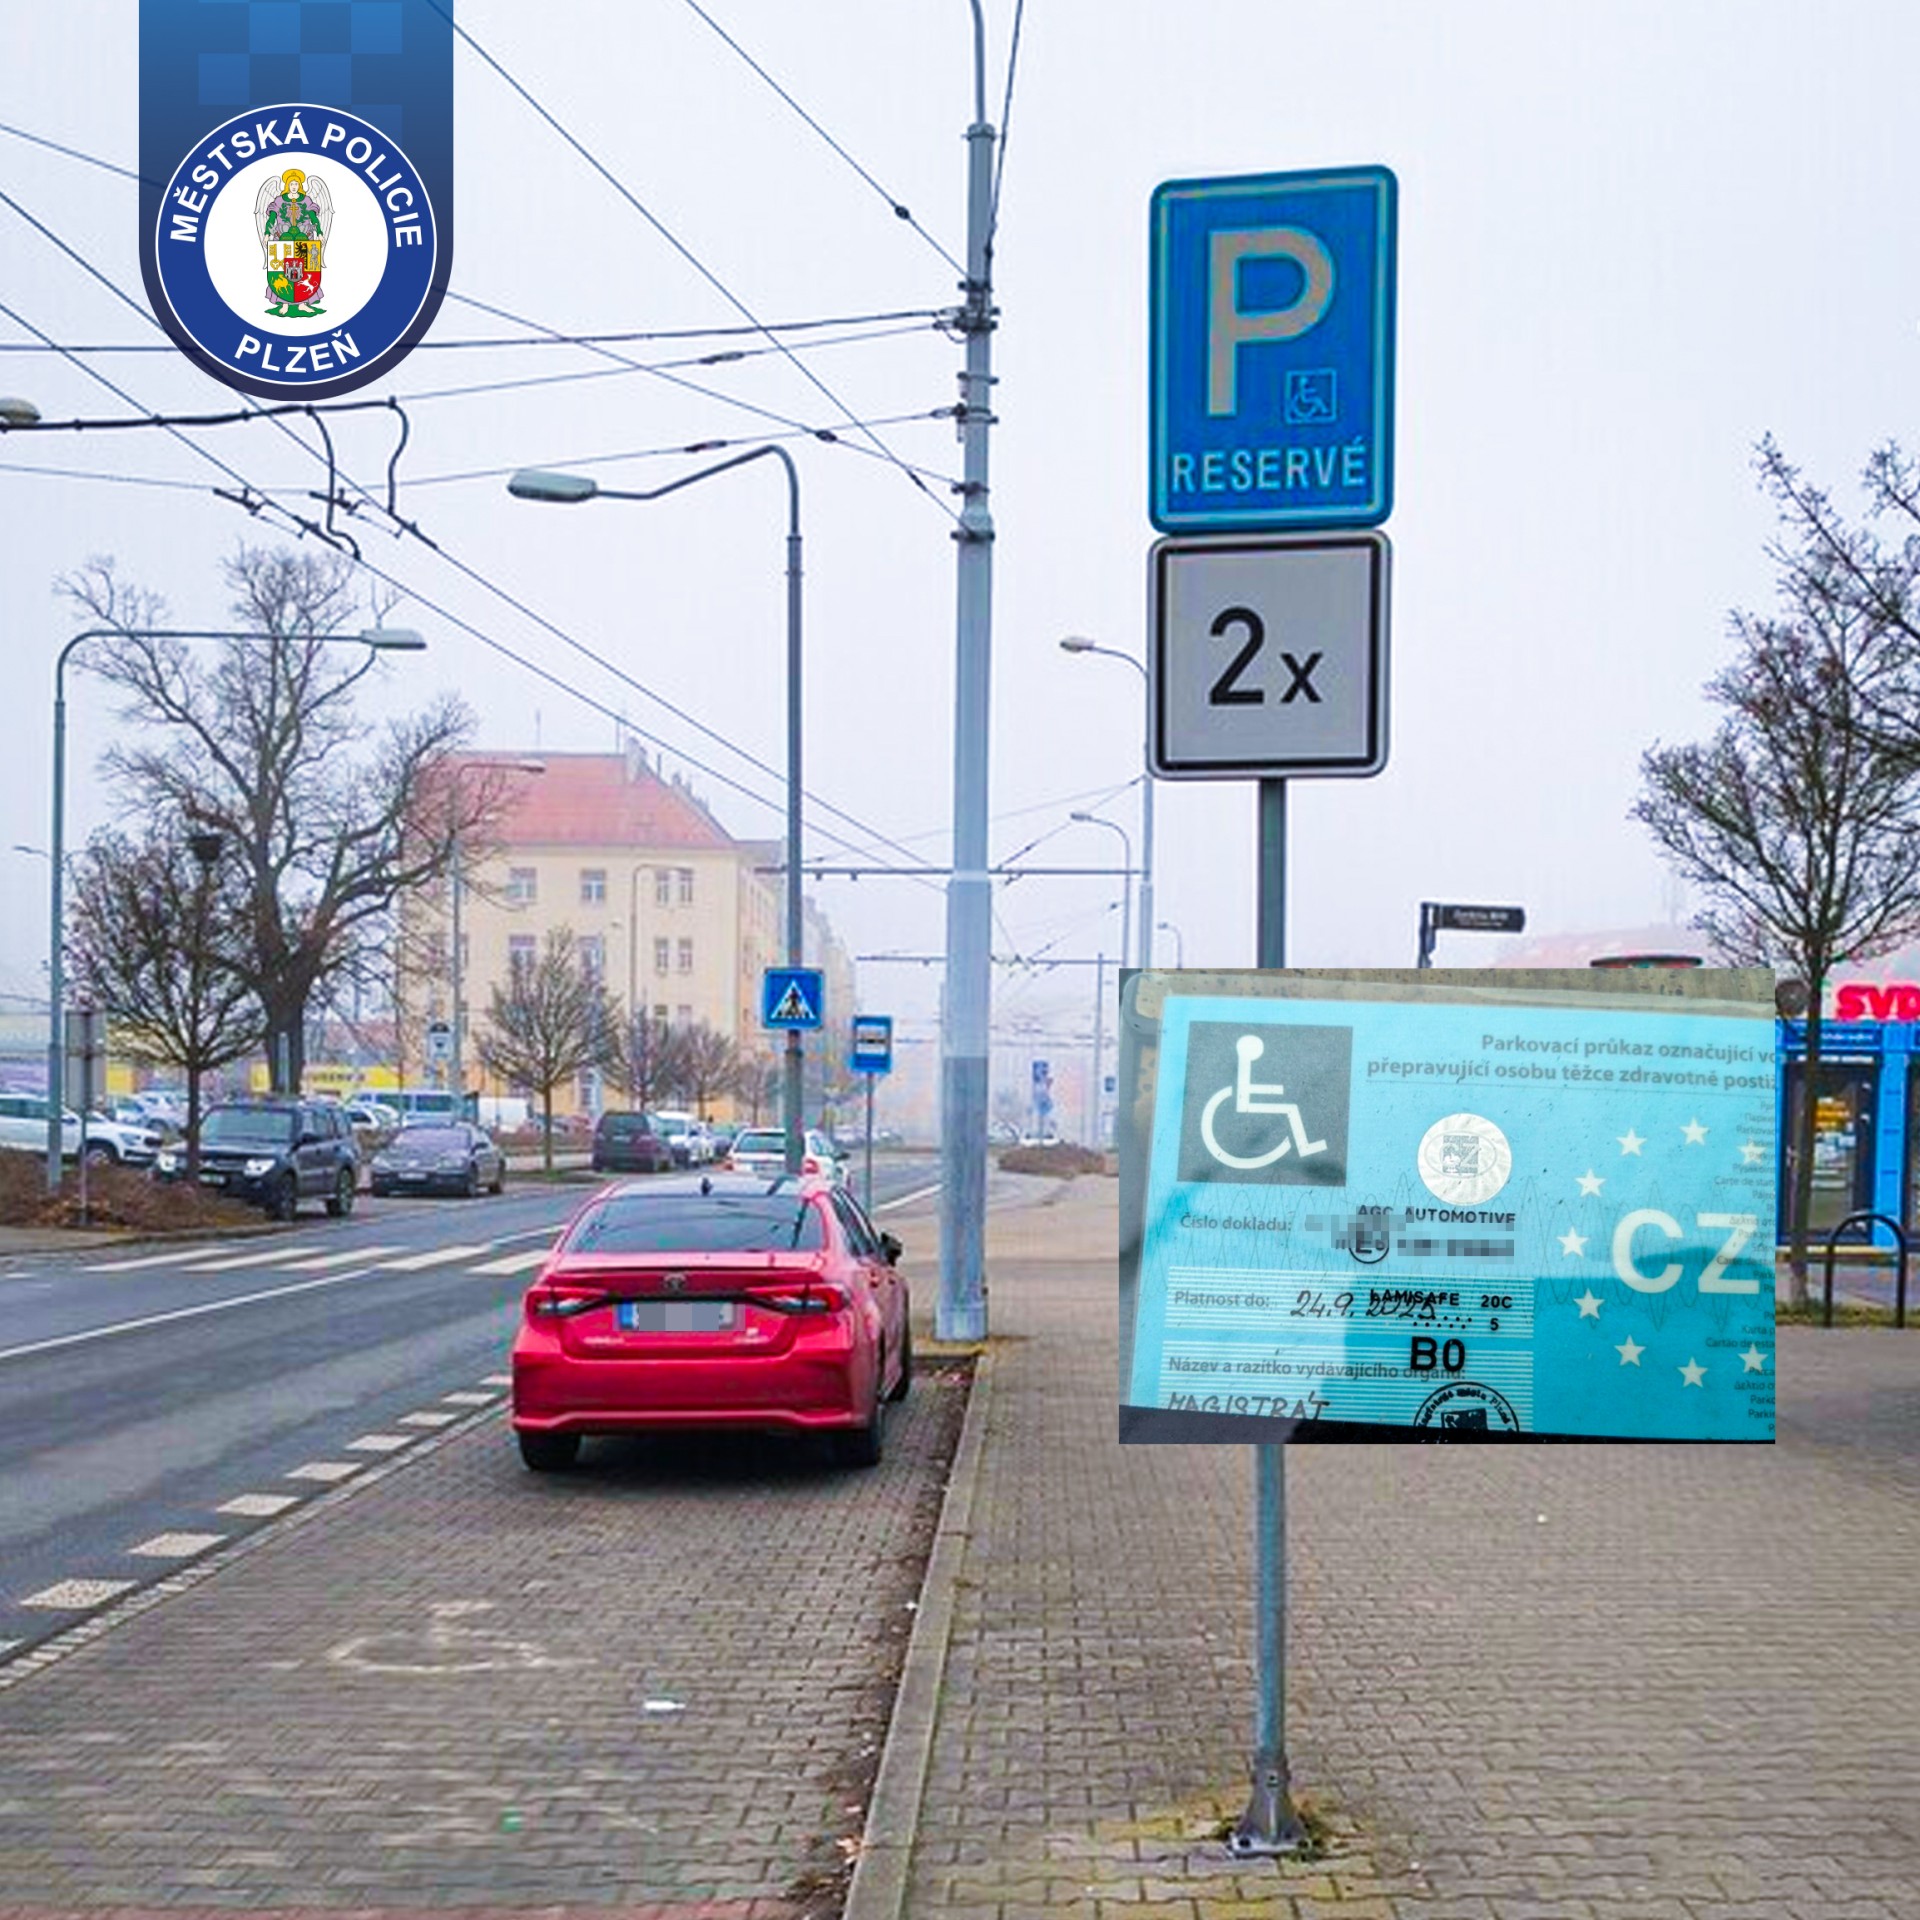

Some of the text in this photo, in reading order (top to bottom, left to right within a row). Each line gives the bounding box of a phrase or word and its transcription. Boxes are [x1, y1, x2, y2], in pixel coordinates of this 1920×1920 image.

[1208, 226, 1336, 417] P
[1171, 435, 1367, 493] RESERVÉ
[1209, 606, 1323, 706] 2x
[1482, 1034, 1578, 1055] Parkovací
[1585, 1038, 1653, 1058] průkaz
[1658, 1043, 1753, 1065] označující
[1367, 1056, 1490, 1080] přepravující
[1494, 1062, 1556, 1080] osobu
[1562, 1065, 1613, 1082] těžce
[1181, 1211, 1218, 1229] Číslo
[1222, 1216, 1292, 1232] dokladu:
[1406, 1207, 1515, 1223] AUTOMOTIVE
[1612, 1208, 1760, 1294] CZ
[1174, 1291, 1270, 1307] Platnost do:
[1480, 1295, 1513, 1309] 20C
[1490, 1318, 1500, 1332] 5
[1169, 1356, 1220, 1373] Název
[1223, 1362, 1232, 1373] a
[1236, 1360, 1292, 1376] razítko
[1296, 1362, 1398, 1380] vydávajícího
